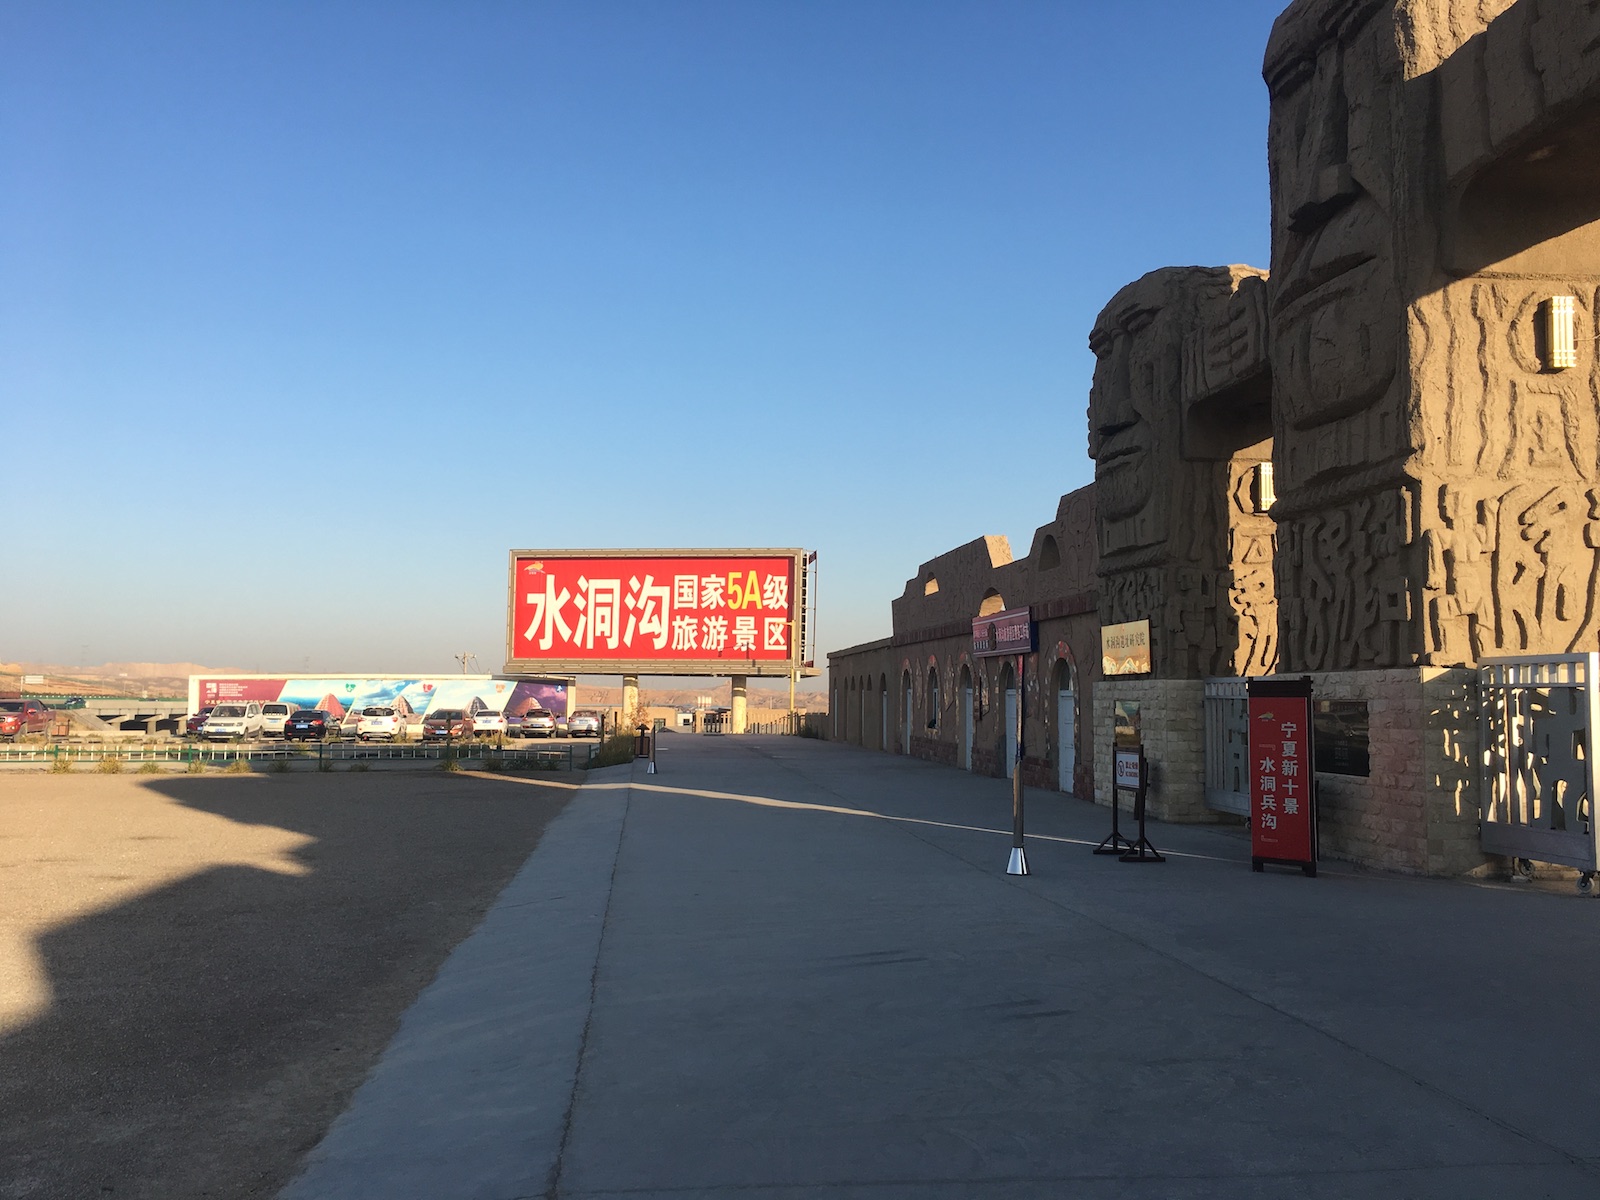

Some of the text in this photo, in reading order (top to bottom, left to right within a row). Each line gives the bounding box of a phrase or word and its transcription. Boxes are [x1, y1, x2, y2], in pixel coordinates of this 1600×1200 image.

[523, 573, 671, 650] 水洞沟
[673, 570, 789, 611] 国家5A级
[671, 615, 788, 652] 旅游景区
[1281, 721, 1299, 815] 宁夏新十景
